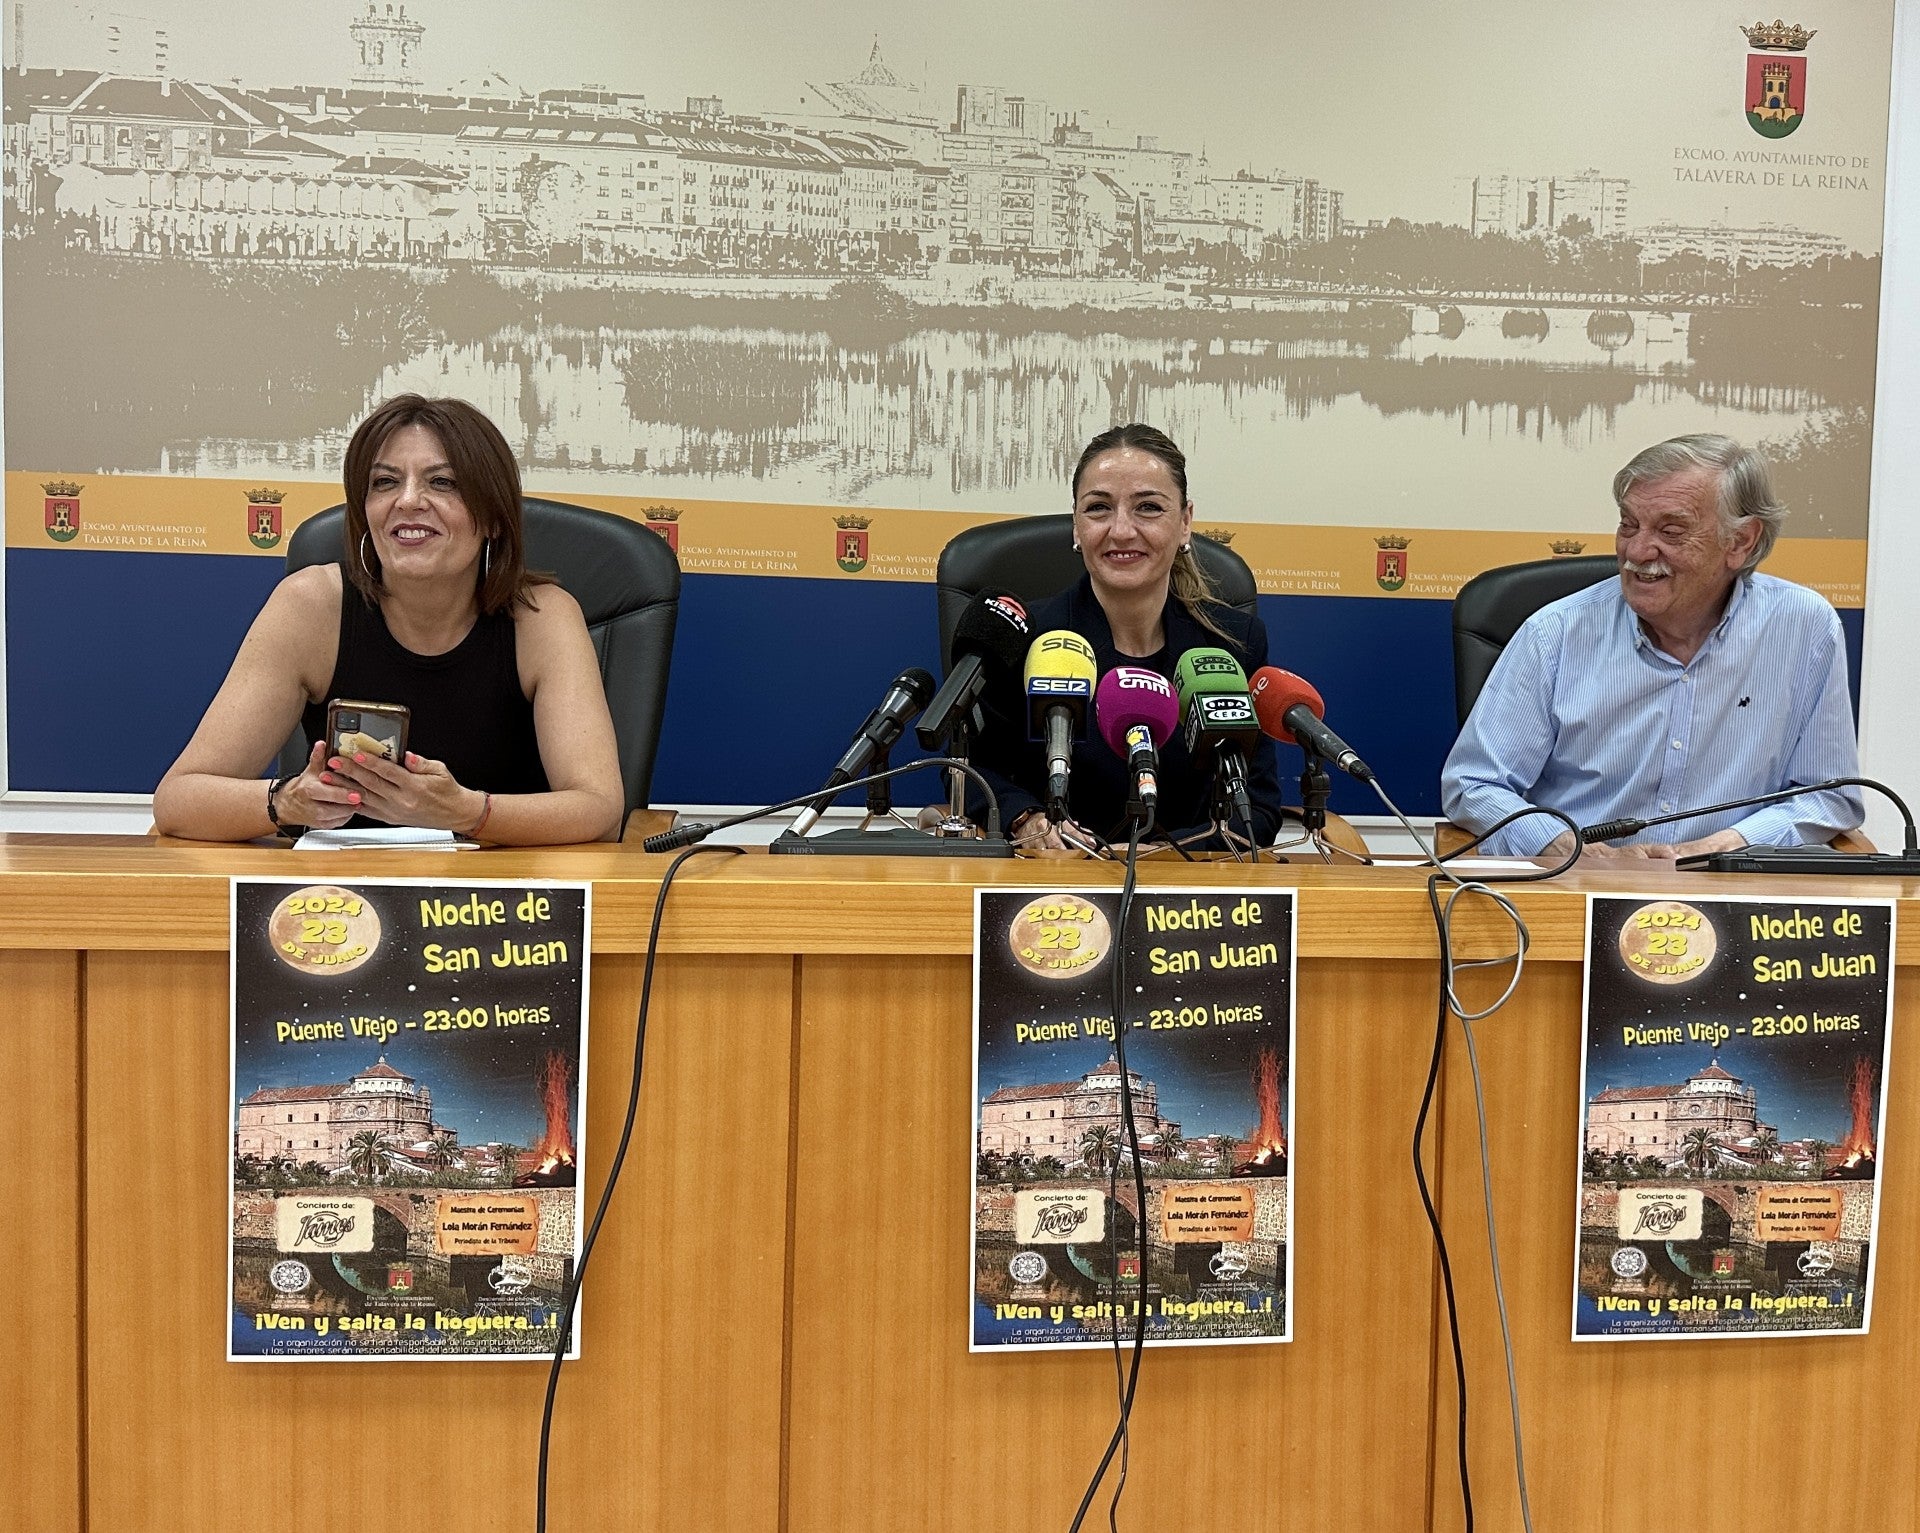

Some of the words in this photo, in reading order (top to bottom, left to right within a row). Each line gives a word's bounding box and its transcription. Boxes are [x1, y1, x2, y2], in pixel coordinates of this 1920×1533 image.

[1674, 147, 1728, 162] EXCMO.
[1733, 151, 1846, 168] AYUNTAMIENTO
[1851, 157, 1869, 169] DE
[1673, 167, 1756, 186] TALAVERA
[1763, 172, 1784, 187] DE
[1792, 173, 1810, 188] LA
[1818, 175, 1868, 190] REINA
[120, 523, 192, 534] AYUNTAMIENTO
[83, 533, 135, 545] TALAVERA
[139, 536, 153, 546] DE
[157, 537, 170, 546] LA
[174, 536, 207, 547] REINA
[716, 547, 785, 558] AYUNTAMIENTO
[905, 555, 938, 564] AYUNTA
[681, 556, 731, 568] TALAVERA
[734, 560, 747, 569] DE
[751, 561, 763, 570] LA
[766, 560, 798, 571] REINA
[871, 564, 919, 576] TALAVERA
[1265, 568, 1328, 578] AYUNTAMIENTO
[1281, 580, 1293, 589] DE
[1297, 581, 1308, 589] LA
[1311, 580, 1340, 590] REINA
[1408, 583, 1454, 594] TALAVERA
[984, 598, 1013, 616] KISS
[1014, 614, 1029, 634] FM
[1202, 664, 1232, 672] CERO
[1031, 679, 1087, 692] SER
[1251, 676, 1269, 702] ne
[1205, 700, 1245, 709] ONDA
[287, 896, 363, 918] 2024
[419, 893, 507, 929] Noche
[516, 891, 551, 922] de
[1025, 904, 1094, 924] 2024
[1145, 899, 1223, 932] Noche
[1231, 897, 1262, 927] de
[1635, 911, 1702, 931] 2024
[1750, 909, 1824, 941] Noche
[1832, 908, 1863, 938] de
[300, 919, 348, 945] 23
[1038, 926, 1082, 950] 23
[281, 940, 308, 960] DE
[311, 943, 368, 966] JUNIO
[1647, 932, 1688, 956] 23
[423, 943, 481, 974] San
[491, 938, 568, 969] Juan
[1020, 947, 1043, 965] DE
[1048, 949, 1099, 969] JUNIO
[1149, 947, 1201, 975] San
[1210, 942, 1278, 970] Juan
[1628, 952, 1651, 969] DE
[1654, 954, 1705, 975] JUNIO
[1753, 955, 1803, 983] San
[1811, 952, 1876, 979] Juan
[276, 1020, 344, 1043] Puente
[350, 1015, 398, 1043] Viejo
[423, 1007, 489, 1033] 23:00
[494, 1004, 550, 1028] horas
[1016, 1019, 1078, 1042] Puente
[1083, 1015, 1126, 1041] Viej
[1149, 1006, 1208, 1030] 23:00
[1212, 1003, 1263, 1026] horas
[1623, 1025, 1683, 1046] Puente
[1687, 1021, 1730, 1048] Viejo
[1751, 1014, 1808, 1037] 23:00
[1812, 1011, 1860, 1033] horas
[296, 1201, 340, 1210] Concierto
[341, 1201, 355, 1209] de:
[1033, 1194, 1073, 1202] Concierto
[1199, 1195, 1207, 1203] de
[477, 1206, 486, 1214] de
[487, 1205, 525, 1214] Ceremonias
[1167, 1211, 1183, 1220] Lola
[1185, 1210, 1209, 1219] Morán
[1210, 1209, 1249, 1219] Fernández
[1761, 1211, 1777, 1220] Lola
[1777, 1210, 1800, 1220] Morán
[1801, 1210, 1837, 1220] Fernández
[442, 1222, 460, 1231] Lola
[461, 1220, 488, 1231] Morán
[490, 1221, 533, 1231] Fernández
[498, 1237, 520, 1245] Tribuna
[995, 1303, 1042, 1320] ¡Ven
[1050, 1303, 1064, 1324] y
[1072, 1301, 1125, 1320] salta
[1597, 1295, 1641, 1312] ¡Ven
[1647, 1298, 1662, 1317] y
[1668, 1294, 1718, 1312] salta
[1724, 1294, 1743, 1310] la
[255, 1313, 306, 1331] ¡Ven
[313, 1316, 330, 1337] y
[337, 1313, 396, 1331] salta
[404, 1313, 426, 1331] la
[262, 1348, 268, 1357] y
[271, 1347, 284, 1355] los
[287, 1347, 325, 1355] menores
[327, 1346, 353, 1355] serán
[272, 1338, 284, 1347] La
[286, 1338, 342, 1348] organización
